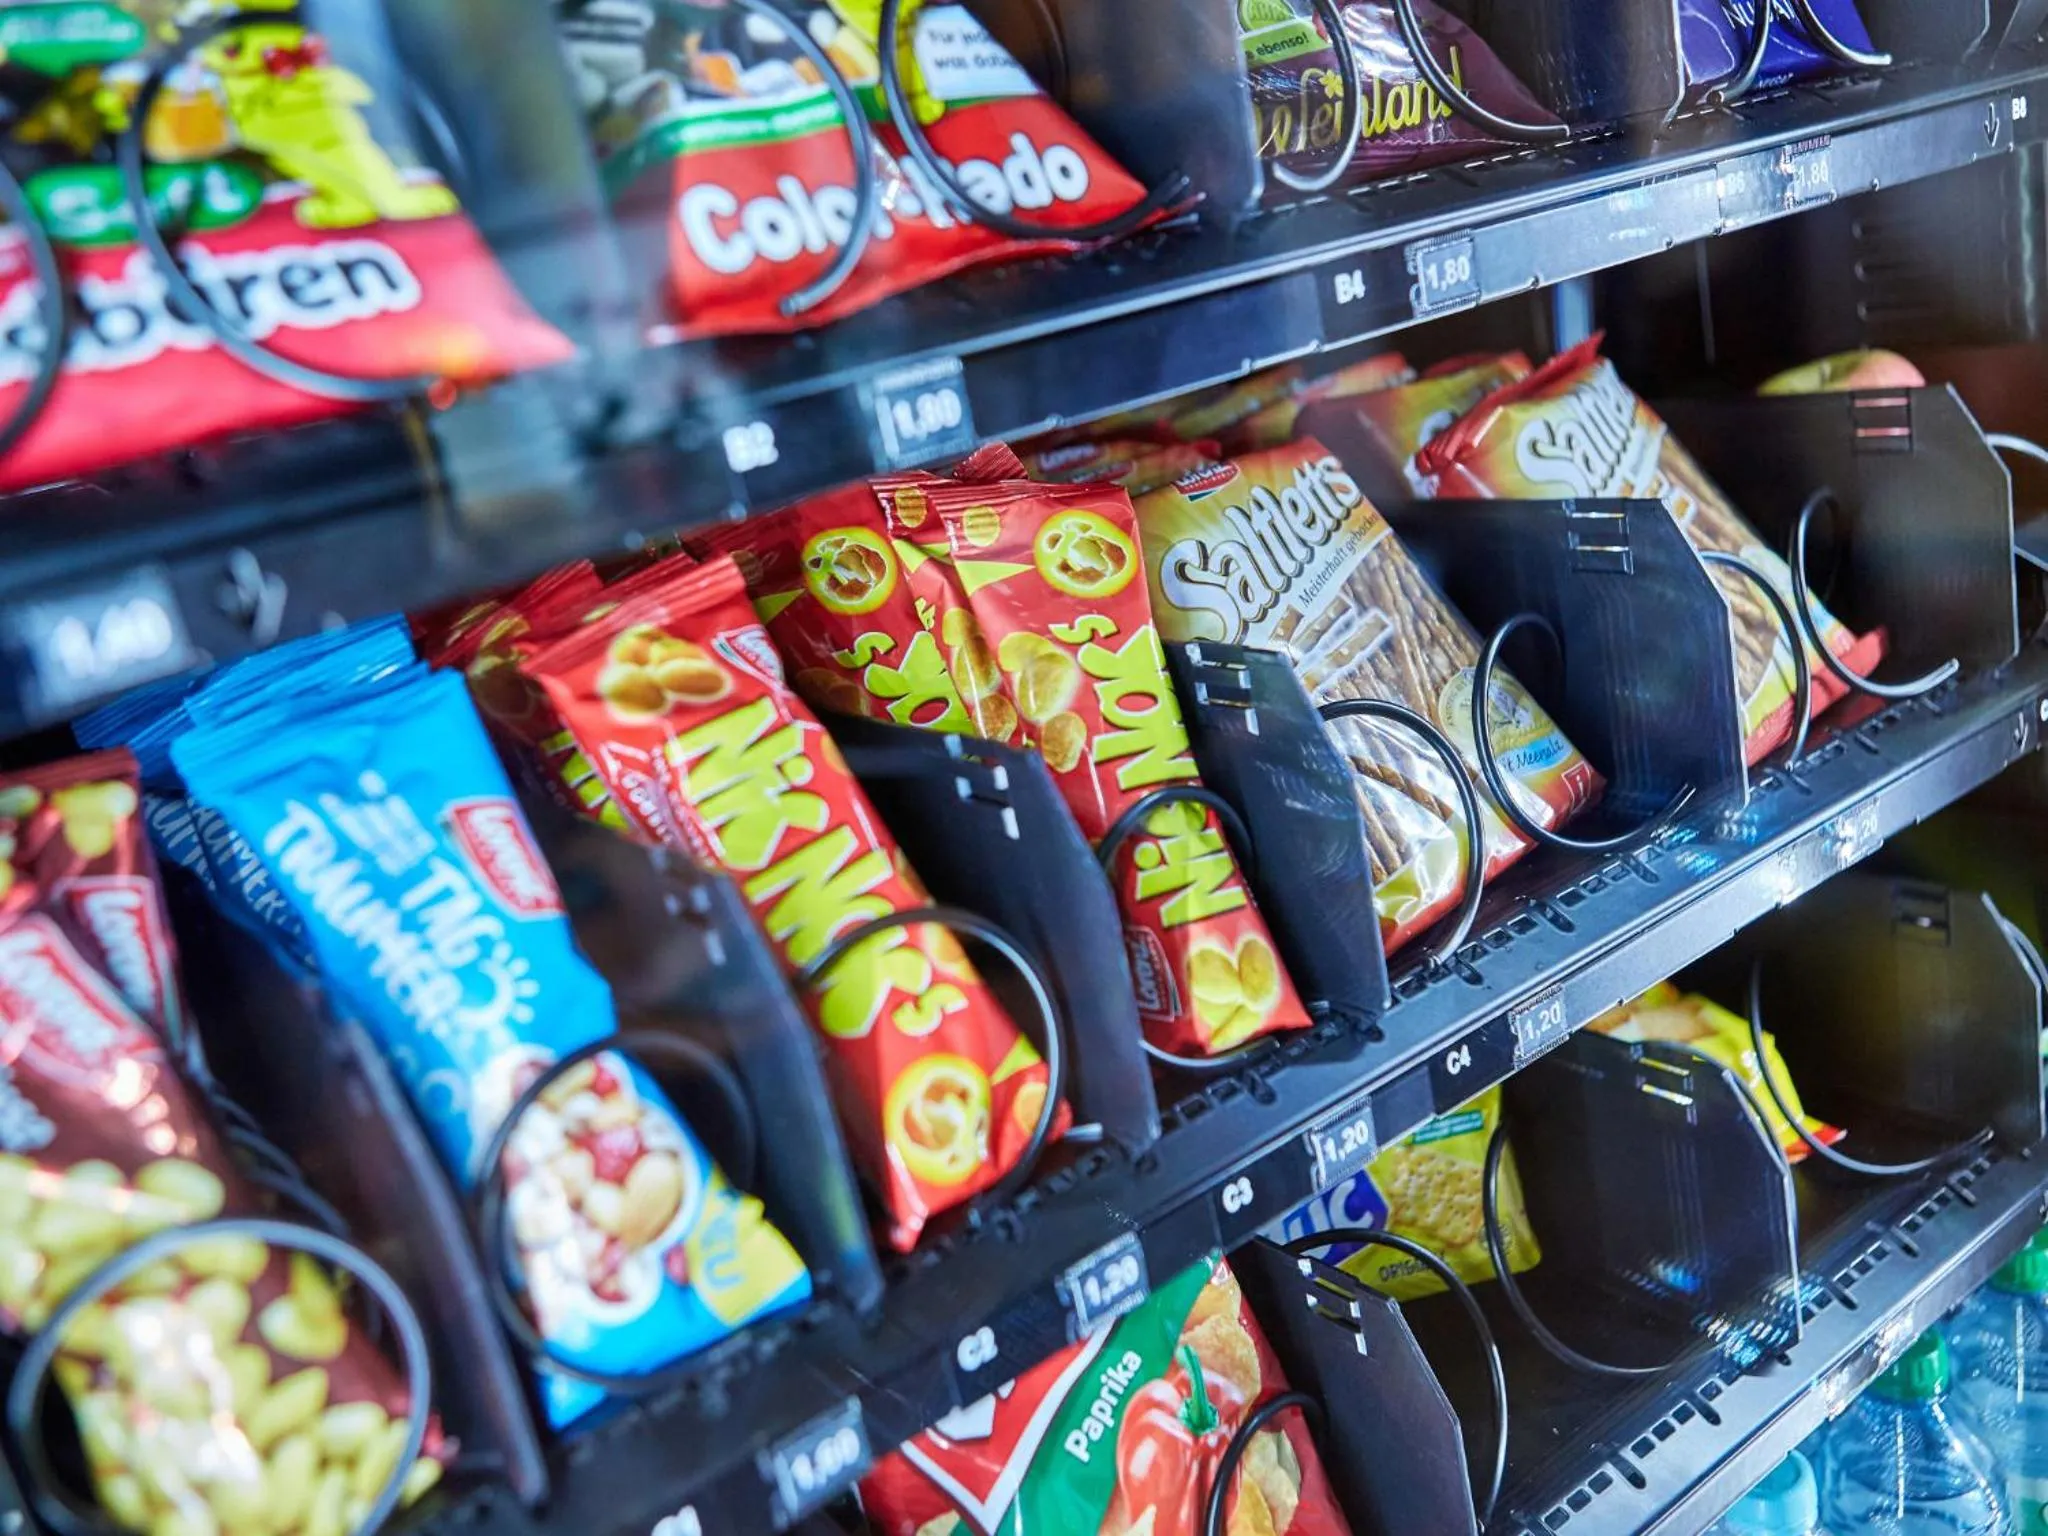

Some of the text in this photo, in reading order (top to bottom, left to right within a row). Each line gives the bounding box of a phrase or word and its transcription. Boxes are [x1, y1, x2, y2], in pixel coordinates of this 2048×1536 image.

[1256, 31, 1309, 56] ebenso!
[1333, 268, 1366, 304] B4
[1427, 254, 1471, 292] 1,80
[1161, 455, 1364, 642] Saltletts
[1521, 1000, 1561, 1042] 1,20
[1446, 1044, 1472, 1076] C4
[1323, 1119, 1369, 1163] 1,20
[1222, 1175, 1254, 1214] C3
[1064, 1350, 1143, 1463] Paprika
